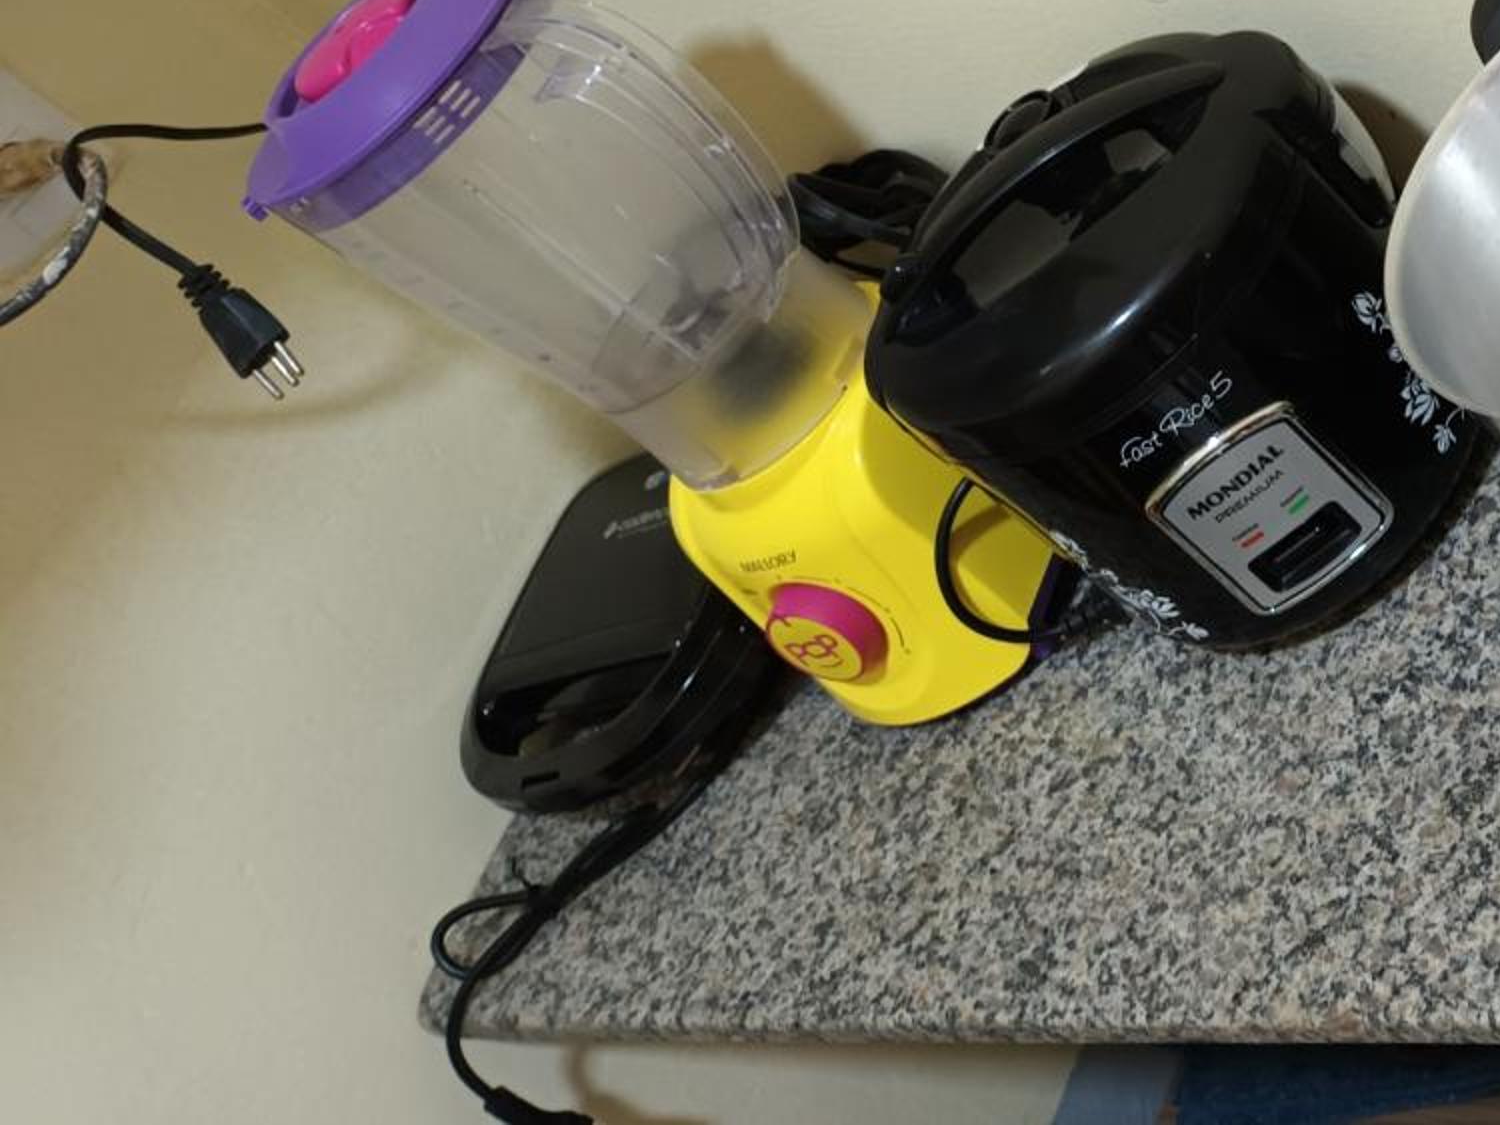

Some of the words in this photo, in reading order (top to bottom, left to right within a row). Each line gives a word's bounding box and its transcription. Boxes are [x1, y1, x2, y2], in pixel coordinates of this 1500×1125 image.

[1159, 394, 1214, 436] Rice
[1210, 370, 1233, 399] 5
[1187, 445, 1284, 521] MONDIAL
[1215, 469, 1284, 524] PREMIUM
